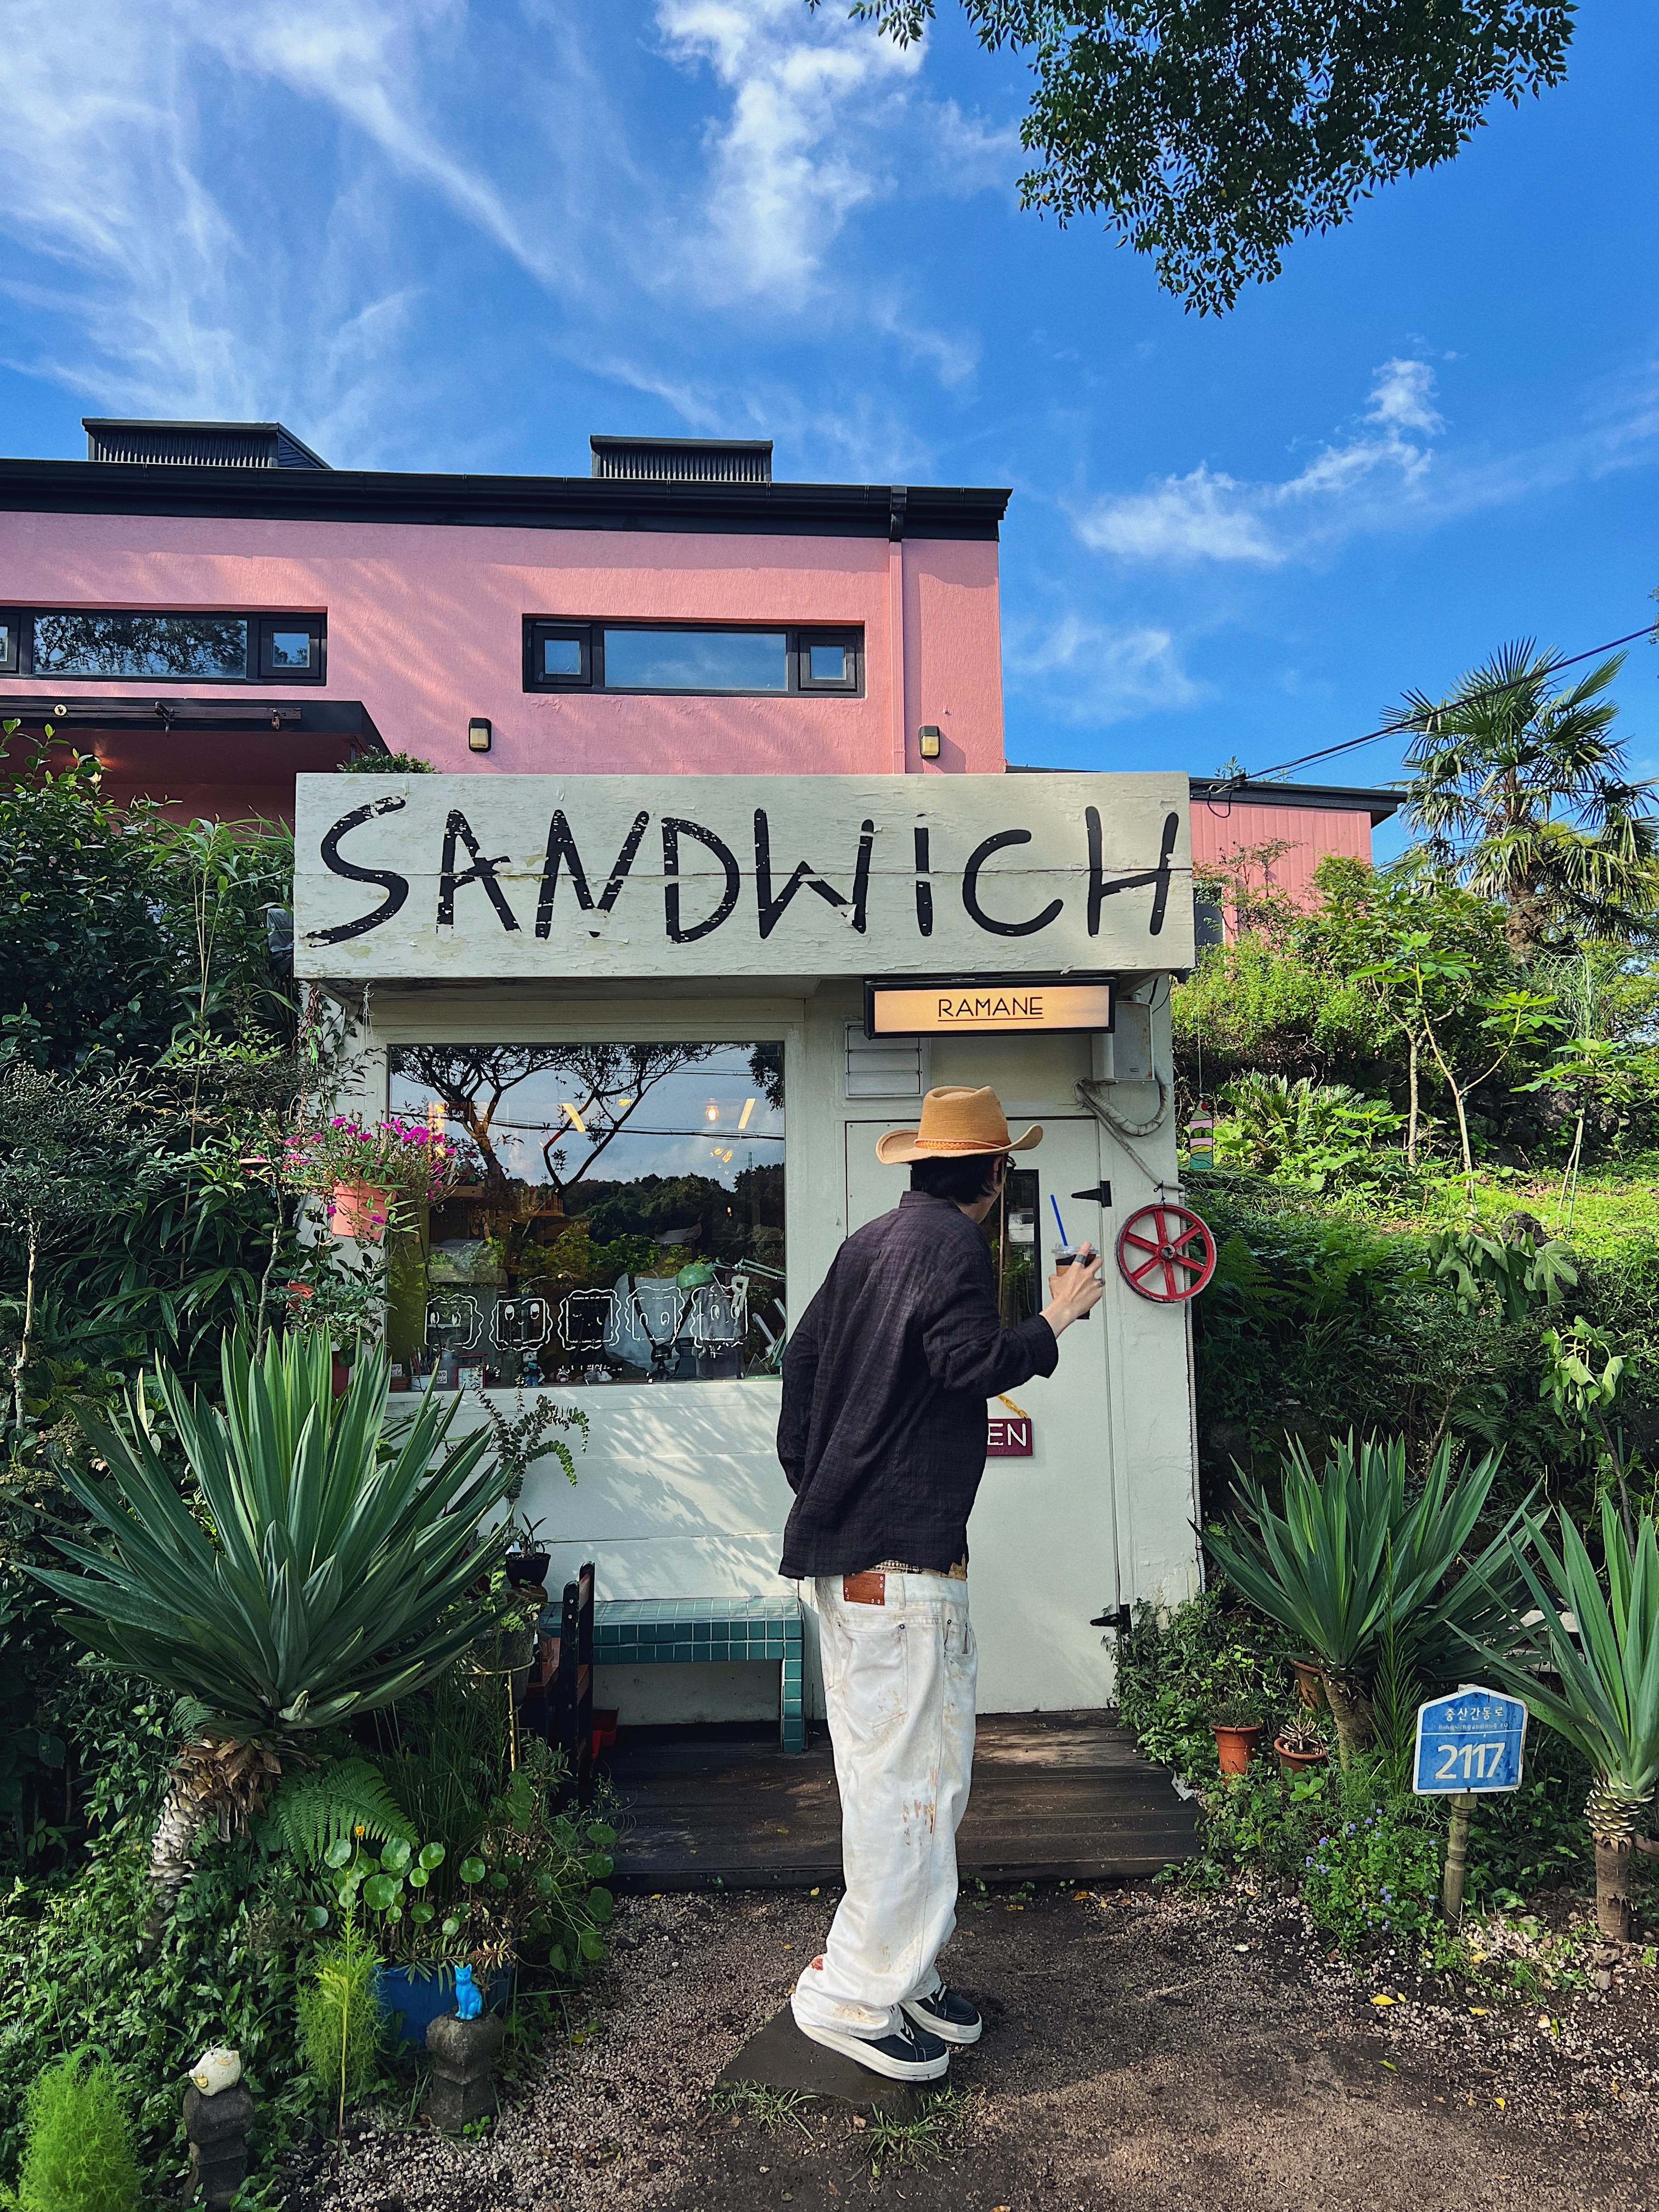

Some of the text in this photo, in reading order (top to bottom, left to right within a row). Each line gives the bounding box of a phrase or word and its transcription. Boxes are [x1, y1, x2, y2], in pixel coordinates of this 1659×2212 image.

[304, 796, 1180, 947] SANDWICH
[939, 997, 1043, 1017] RAMANE
[988, 1423, 1026, 1446] EN
[1444, 1706, 1504, 1722] 중산간동로
[1435, 1742, 1506, 1780] 2117
